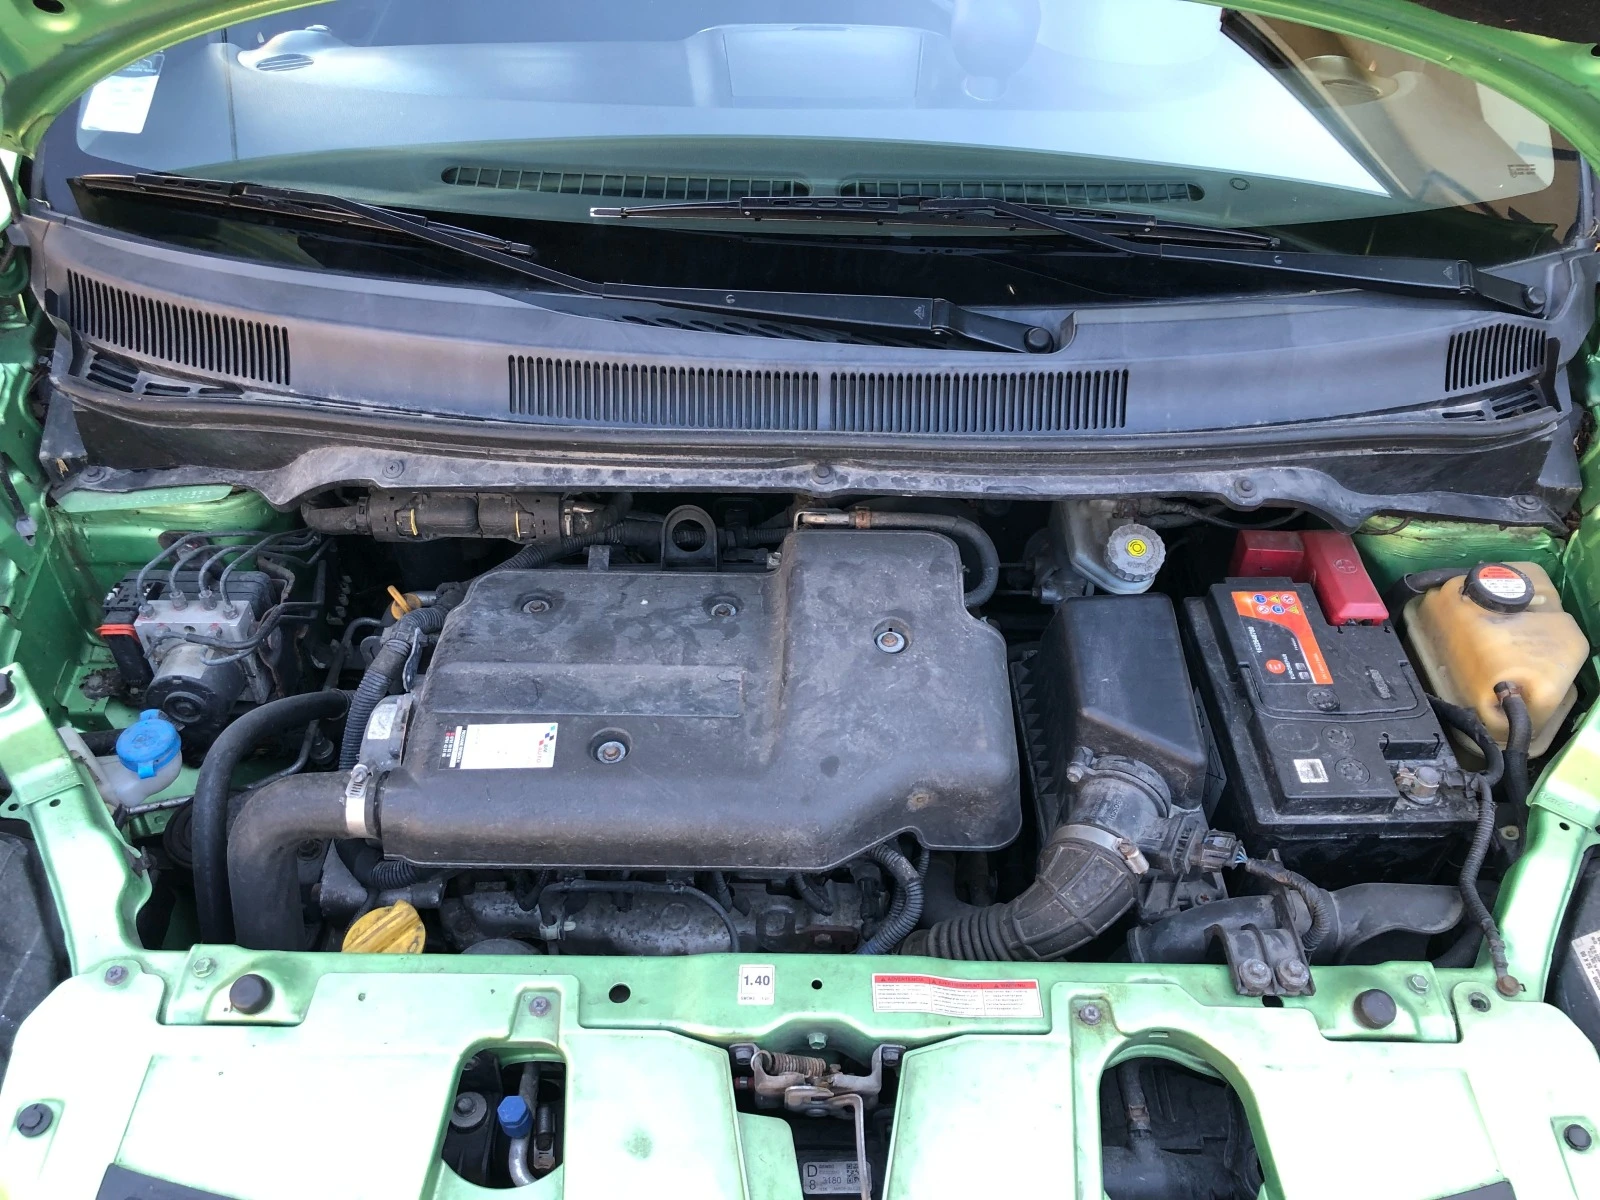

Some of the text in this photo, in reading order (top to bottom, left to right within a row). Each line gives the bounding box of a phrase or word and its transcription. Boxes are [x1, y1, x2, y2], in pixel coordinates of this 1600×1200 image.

[744, 975, 770, 986] 1.40
[808, 1165, 817, 1177] D
[809, 1180, 817, 1190] 8
